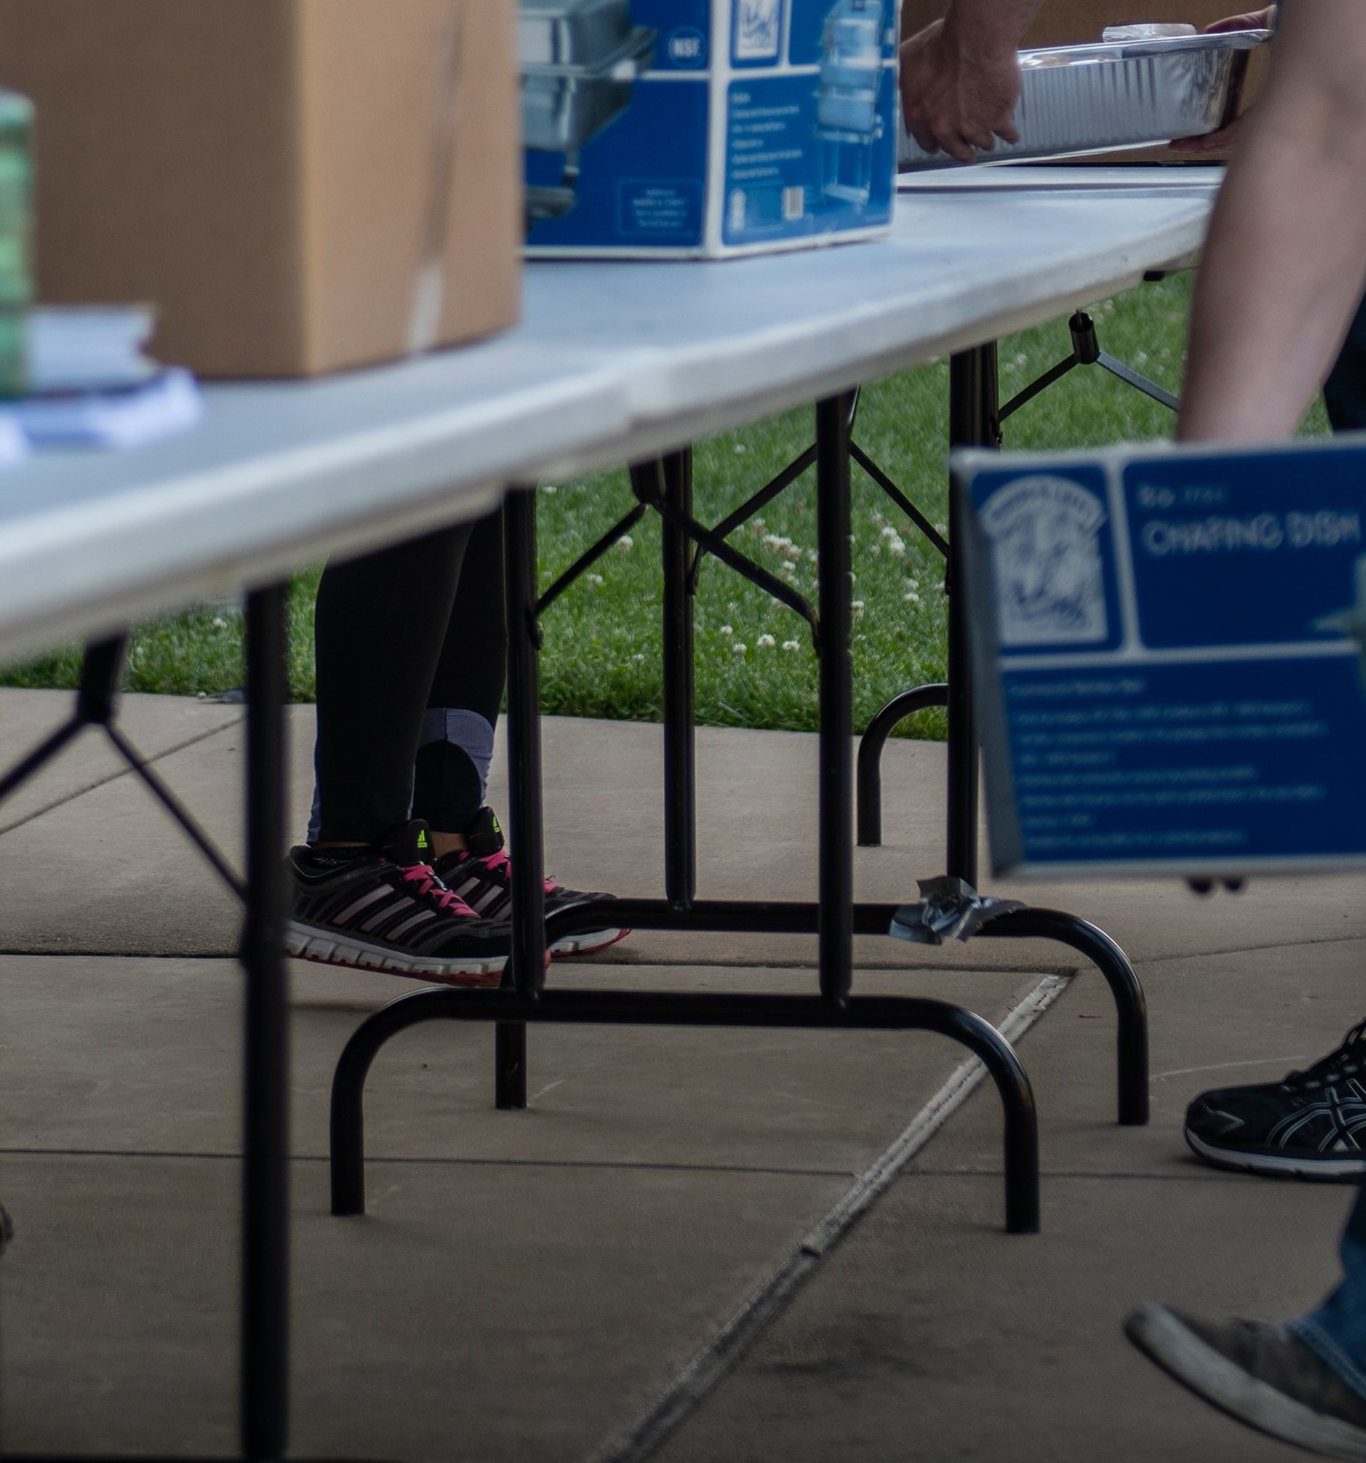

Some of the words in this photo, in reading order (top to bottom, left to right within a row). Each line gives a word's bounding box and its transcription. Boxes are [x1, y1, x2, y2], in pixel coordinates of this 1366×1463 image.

[674, 36, 701, 58] NSF
[1140, 514, 1285, 556] CHAFING
[1287, 508, 1362, 549] DISH
